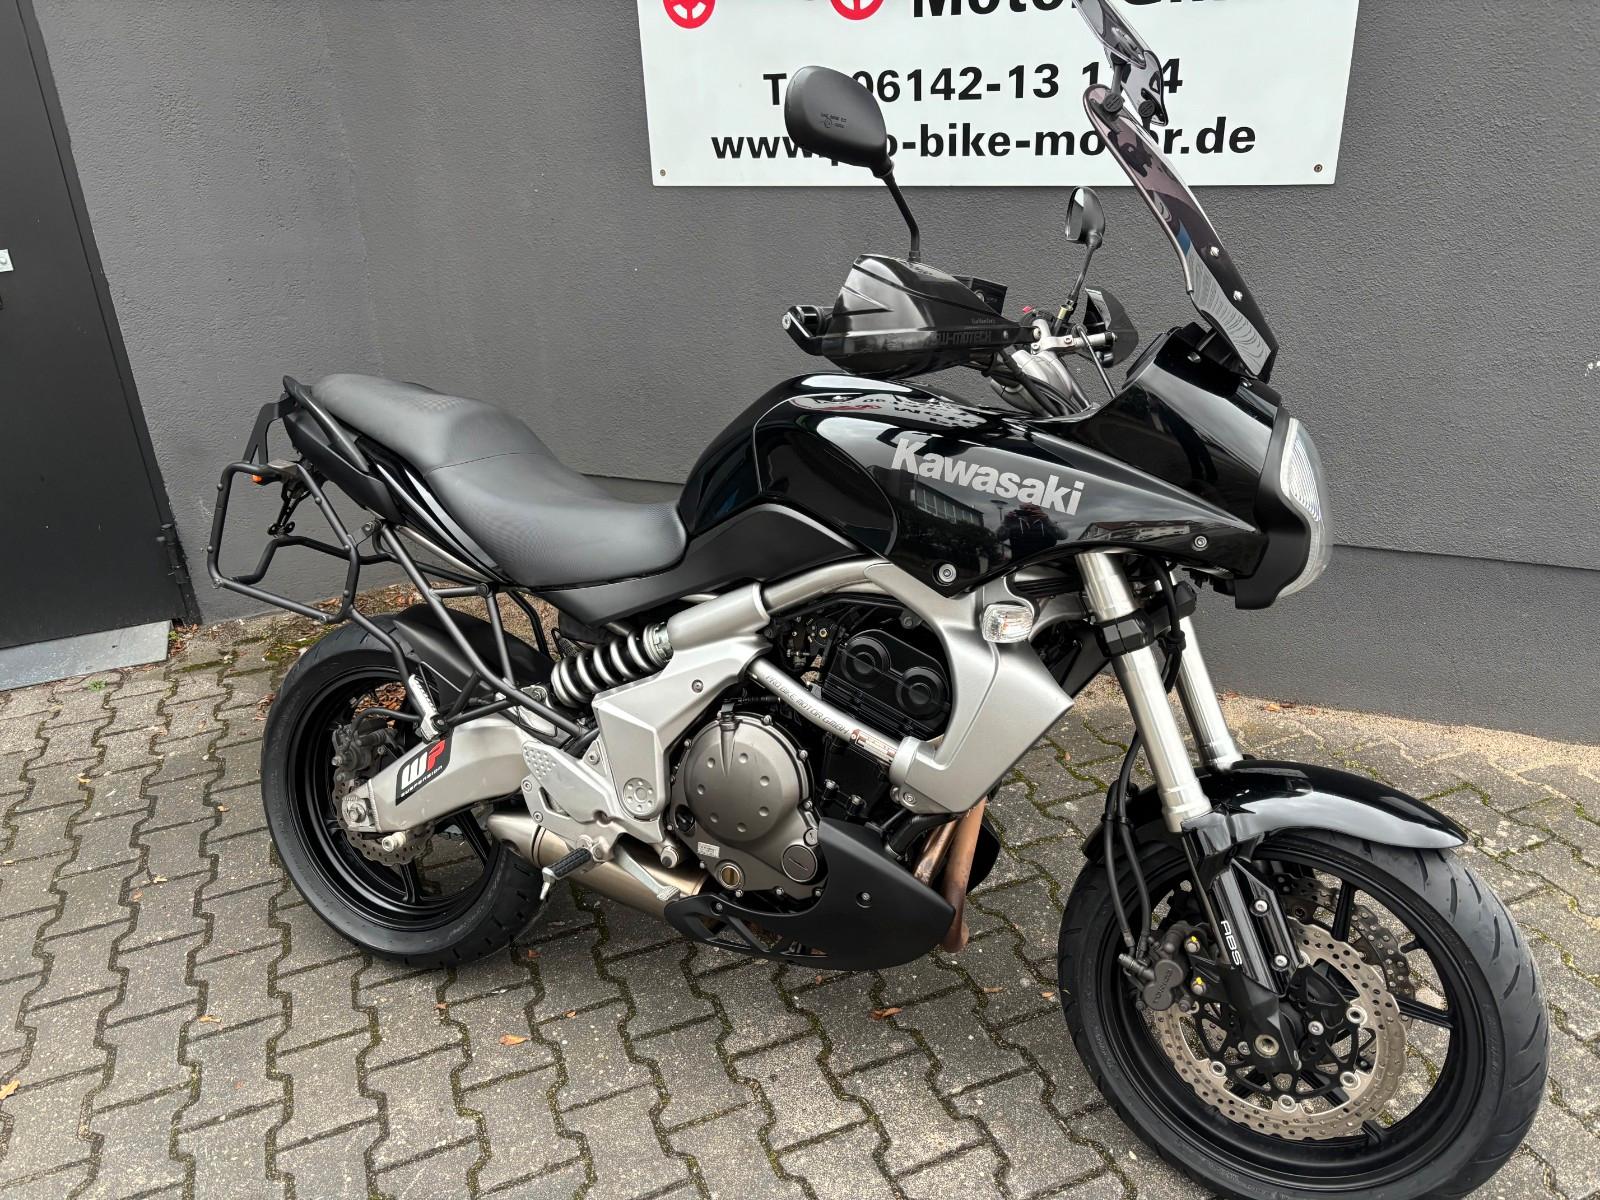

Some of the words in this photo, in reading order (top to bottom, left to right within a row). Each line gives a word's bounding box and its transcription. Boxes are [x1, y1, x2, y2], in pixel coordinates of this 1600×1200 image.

[1082, 58, 1183, 93] 14
[891, 438, 1085, 516] Kawasaki
[1221, 920, 1242, 966] ABS
